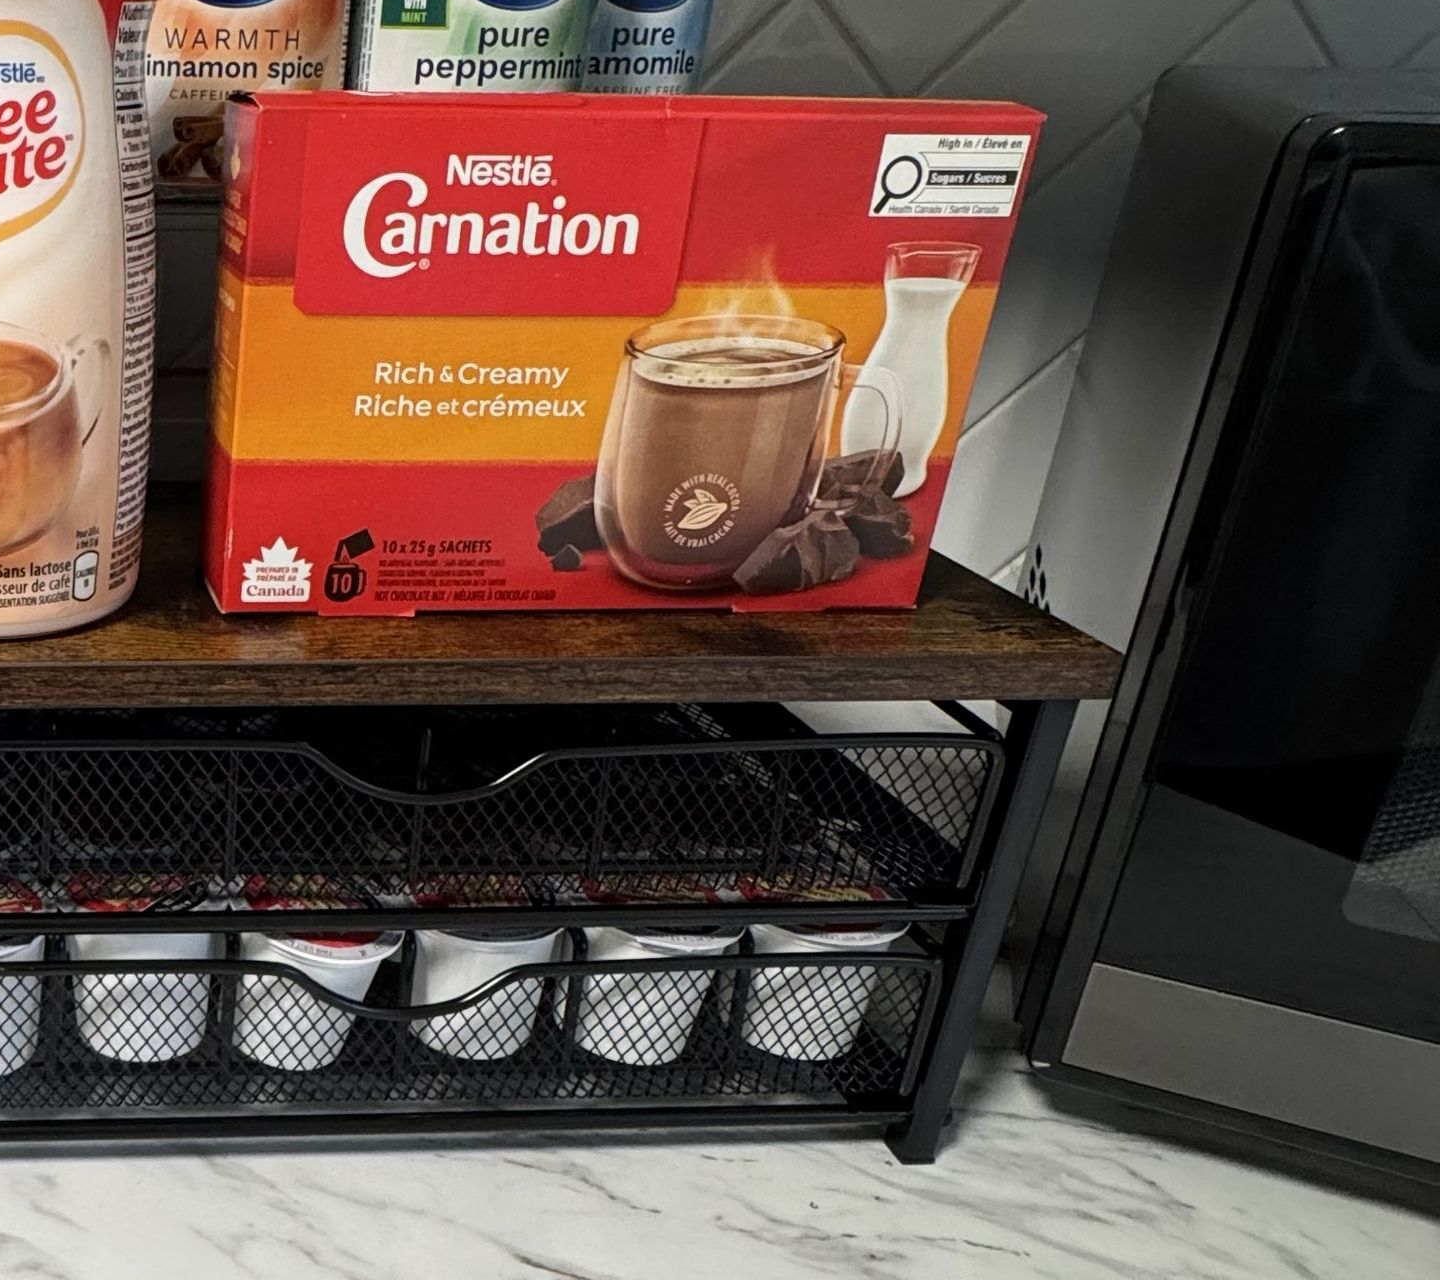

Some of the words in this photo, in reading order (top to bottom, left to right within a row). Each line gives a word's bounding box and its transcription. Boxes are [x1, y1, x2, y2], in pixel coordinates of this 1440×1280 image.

[400, 11, 428, 23] MINT
[165, 28, 300, 51] WARMTH
[477, 27, 550, 54] pure
[611, 26, 675, 53] pure
[147, 53, 257, 78] innamon
[267, 56, 324, 85] spice
[414, 51, 582, 87] peppermint
[587, 49, 694, 75] amomile
[938, 137, 961, 150] High
[963, 138, 973, 149] in
[982, 137, 1008, 149] Élevé
[1010, 140, 1023, 149] en
[446, 154, 553, 186] Nestlé
[930, 173, 964, 185] Sugars
[973, 173, 1007, 184] Sucres
[888, 205, 912, 214] Health
[914, 205, 942, 214] Canada
[949, 204, 970, 214] Santé
[972, 205, 1000, 214] Canada
[342, 172, 639, 278] Carnation
[374, 361, 434, 385] Rich
[439, 365, 453, 383] &
[458, 362, 569, 389] Creamy
[354, 394, 432, 417] Riche
[436, 397, 459, 416] et
[462, 394, 586, 417] crémeux
[664, 488, 683, 512] MADE
[681, 474, 705, 490] WITH
[707, 473, 728, 487] REAL
[725, 482, 740, 511] COCOA
[664, 521, 678, 538] FAIT
[674, 534, 687, 546] DE
[687, 537, 708, 548] VRAI
[707, 519, 734, 544] CACAO
[382, 540, 398, 554] 10
[399, 544, 406, 553] x
[410, 540, 426, 554] 25
[427, 544, 436, 557] g
[439, 540, 491, 554] SACHETS
[30, 561, 72, 577] lactose
[31, 579, 46, 593] de
[49, 575, 71, 592] café
[246, 585, 305, 597] Canada
[331, 573, 352, 594] 10
